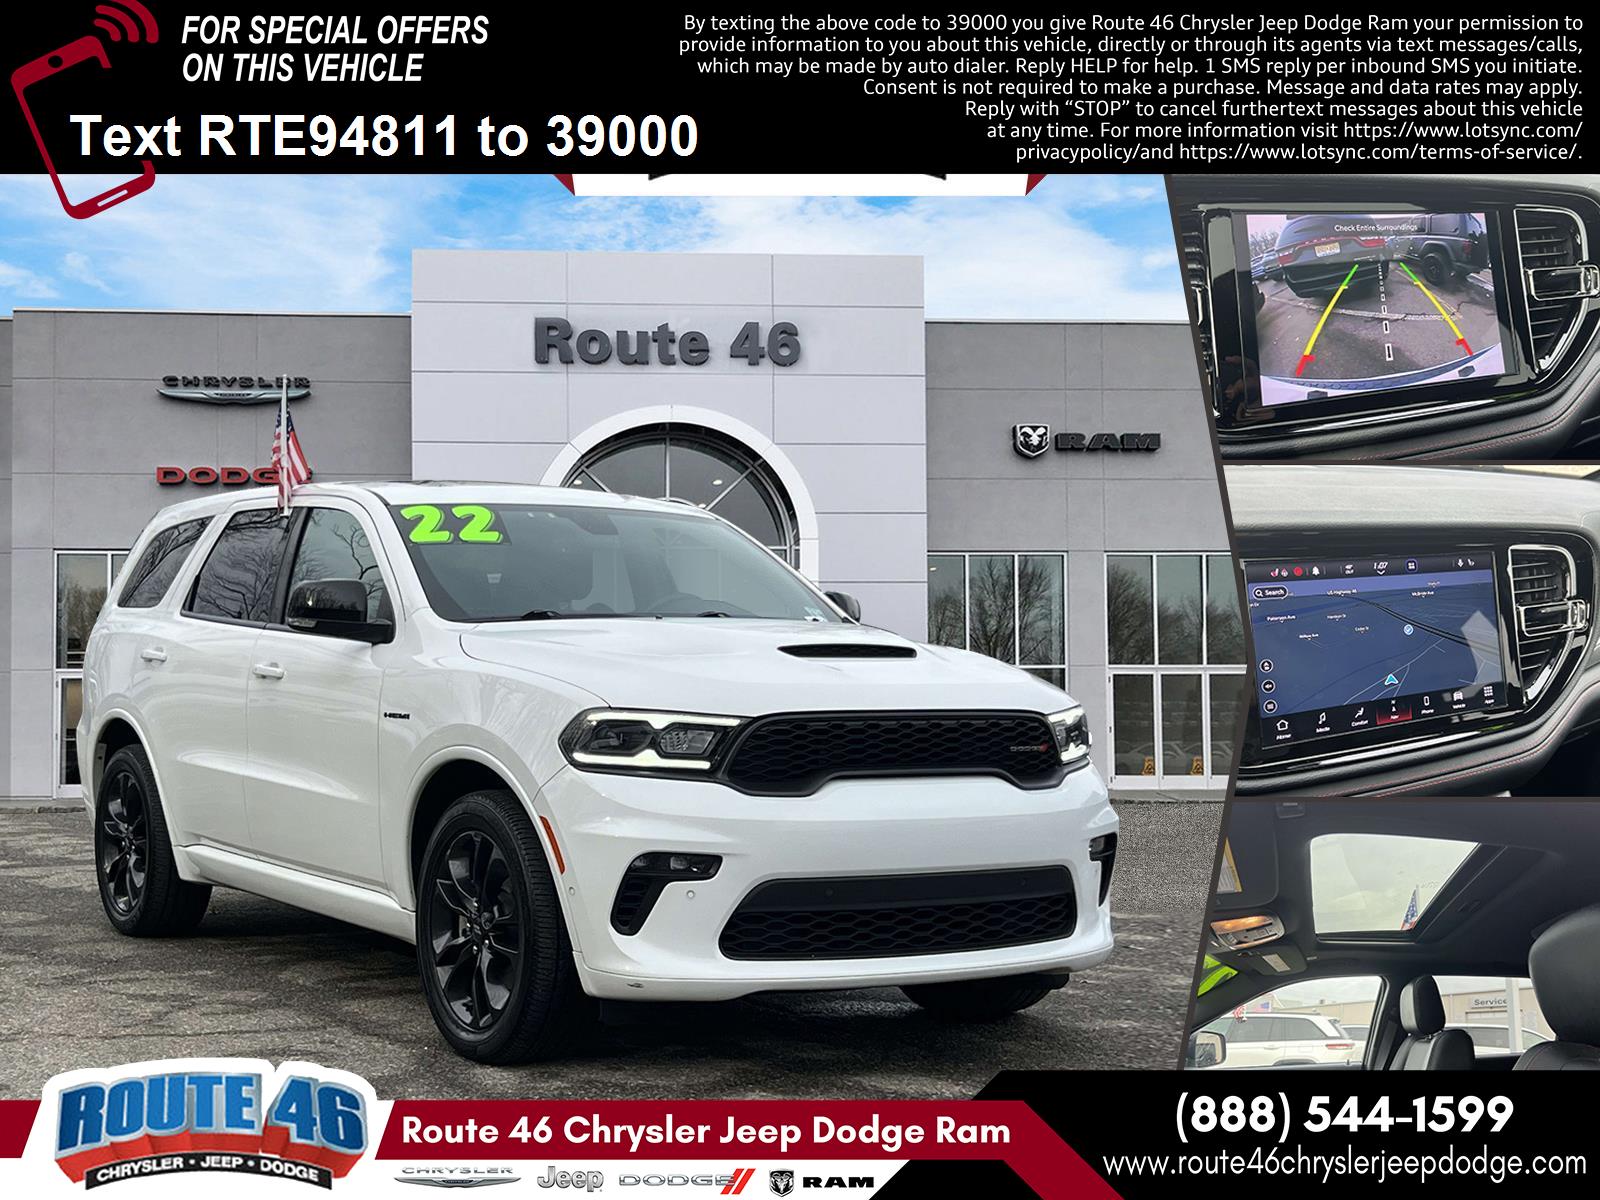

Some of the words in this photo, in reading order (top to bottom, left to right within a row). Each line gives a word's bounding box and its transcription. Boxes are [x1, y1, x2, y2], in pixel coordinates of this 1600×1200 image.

[1334, 223, 1355, 232] Check
[1356, 223, 1376, 232] Entire
[1376, 222, 1418, 233] Surroundings
[533, 316, 711, 366] Route
[729, 320, 802, 367] 46
[162, 375, 311, 389] CHRYSLER
[1054, 431, 1162, 451] RAM
[156, 466, 313, 485] DODG
[399, 504, 503, 544] 22
[1264, 588, 1285, 597] Search
